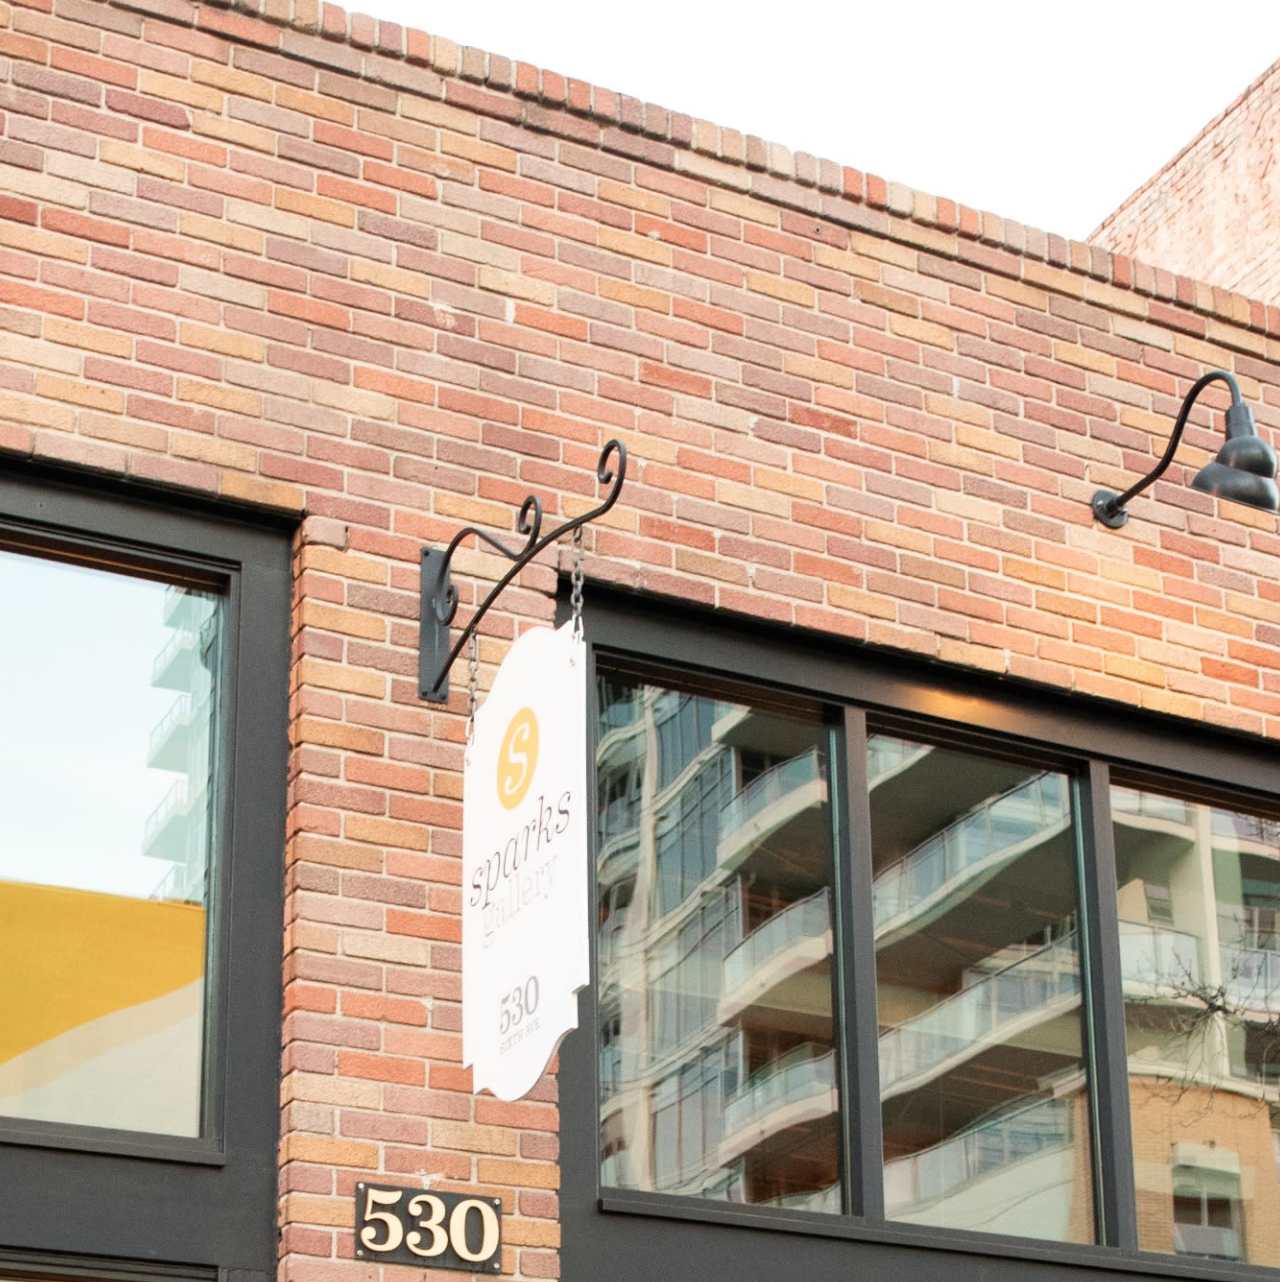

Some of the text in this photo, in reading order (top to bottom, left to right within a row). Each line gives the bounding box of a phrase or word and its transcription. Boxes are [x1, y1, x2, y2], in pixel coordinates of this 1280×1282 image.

[469, 790, 572, 911] sparks
[499, 975, 541, 1036] 530
[359, 1189, 500, 1264] 530
